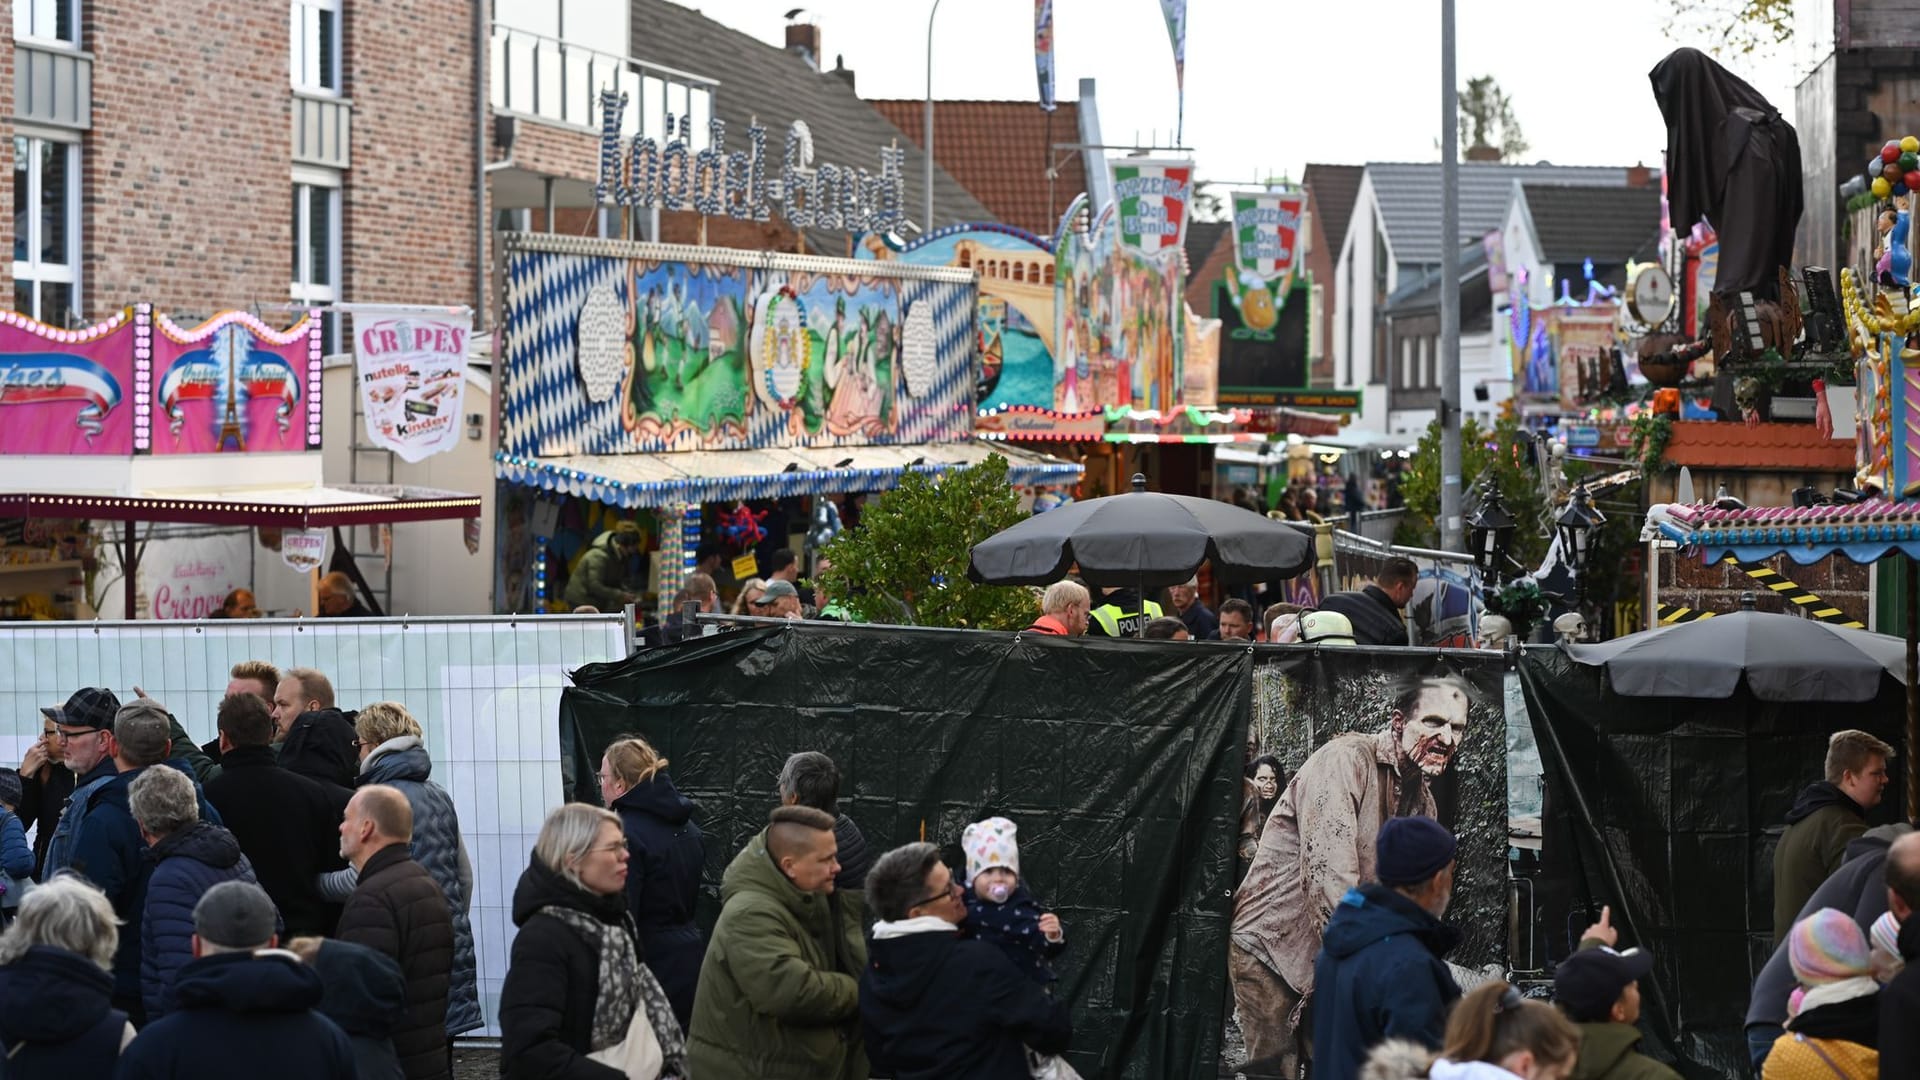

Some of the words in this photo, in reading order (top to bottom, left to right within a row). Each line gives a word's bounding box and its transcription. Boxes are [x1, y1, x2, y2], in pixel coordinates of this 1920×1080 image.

[1114, 177, 1190, 201] PIZZERIA
[1137, 200, 1168, 219] Don
[1124, 217, 1176, 234] Benito
[364, 363, 411, 382] nutella
[396, 415, 448, 436] kinder
[1008, 417, 1056, 431] Salami
